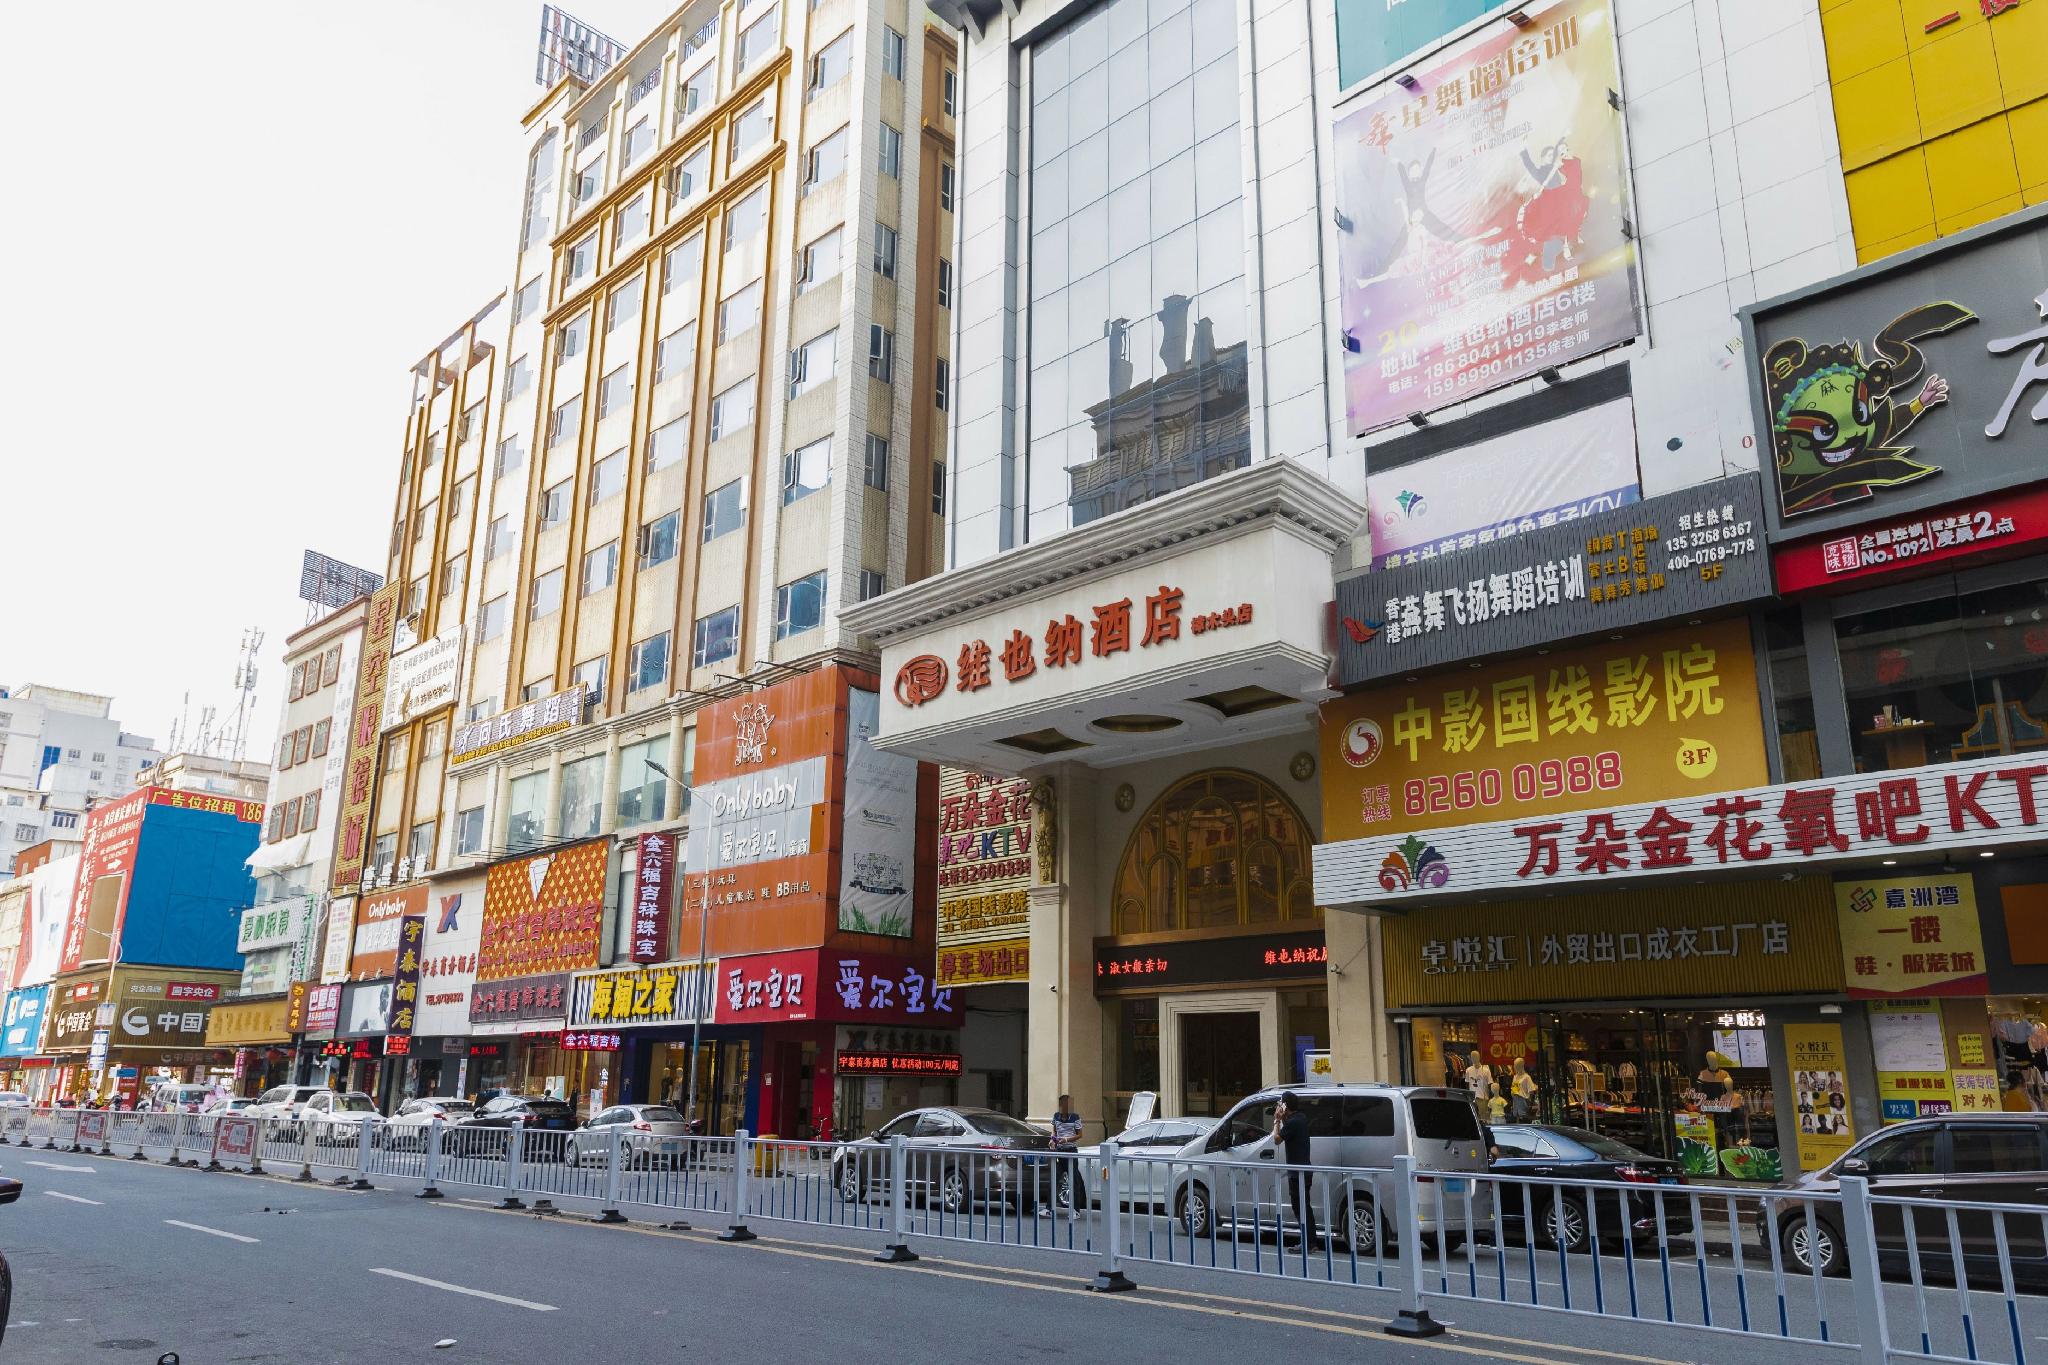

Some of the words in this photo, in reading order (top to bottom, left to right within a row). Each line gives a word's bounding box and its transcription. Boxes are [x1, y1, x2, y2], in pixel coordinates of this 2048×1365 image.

[1442, 281, 1596, 356] 维也纳酒店6楼
[1424, 359, 1456, 380] 186
[1458, 342, 1501, 368] 8041
[1423, 379, 1455, 400] 159
[1457, 361, 1503, 387] 8990
[1678, 504, 1736, 532] 招生热线
[1930, 513, 1972, 533] 营业至
[1936, 510, 2016, 548] 凌晨2点
[1665, 536, 1689, 552] 135
[1690, 530, 1720, 548] 3268
[1722, 520, 1752, 540] 6367
[1860, 522, 1924, 550] 全国连锁
[1666, 538, 1756, 572] 400-0769-778
[1701, 562, 1724, 582] 5F
[1399, 553, 1587, 641] 燕舞飞扬舞蹈培训
[955, 583, 1185, 694] 维也纳酒店
[1384, 597, 1401, 645] 香港
[1392, 643, 1726, 763] 中影国线影院
[1681, 745, 1713, 768] 3F
[1362, 784, 1392, 806] 订票
[1403, 768, 1503, 816] 8260
[1511, 751, 1623, 801] 0988
[940, 780, 1031, 834] 万朵金花
[1362, 803, 1392, 825] 热线
[719, 827, 778, 862] 爱尔宝贝
[635, 834, 665, 957] 金六福吉祥珠宝
[942, 889, 1028, 922] 中影国线影院
[1884, 885, 1960, 910] 嘉洲湾
[1419, 933, 1518, 966] 卓悦汇
[1540, 919, 1791, 967] 外贸出口成衣工厂店
[1877, 915, 1943, 945] 一楼
[391, 920, 424, 1030] 宇泰酒店
[941, 947, 1029, 983] 停车场出口
[1109, 957, 1169, 976] 淑女般亲切
[1423, 961, 1514, 976] OUTLET
[171, 985, 215, 998] 国字央企
[589, 969, 679, 1020] 海澜之家
[726, 966, 804, 1012] 爱尔宝贝
[834, 958, 954, 1014] 爱尔宝贝
[157, 1010, 209, 1034] 中国
[838, 1055, 888, 1069] 宇泰商务酒店
